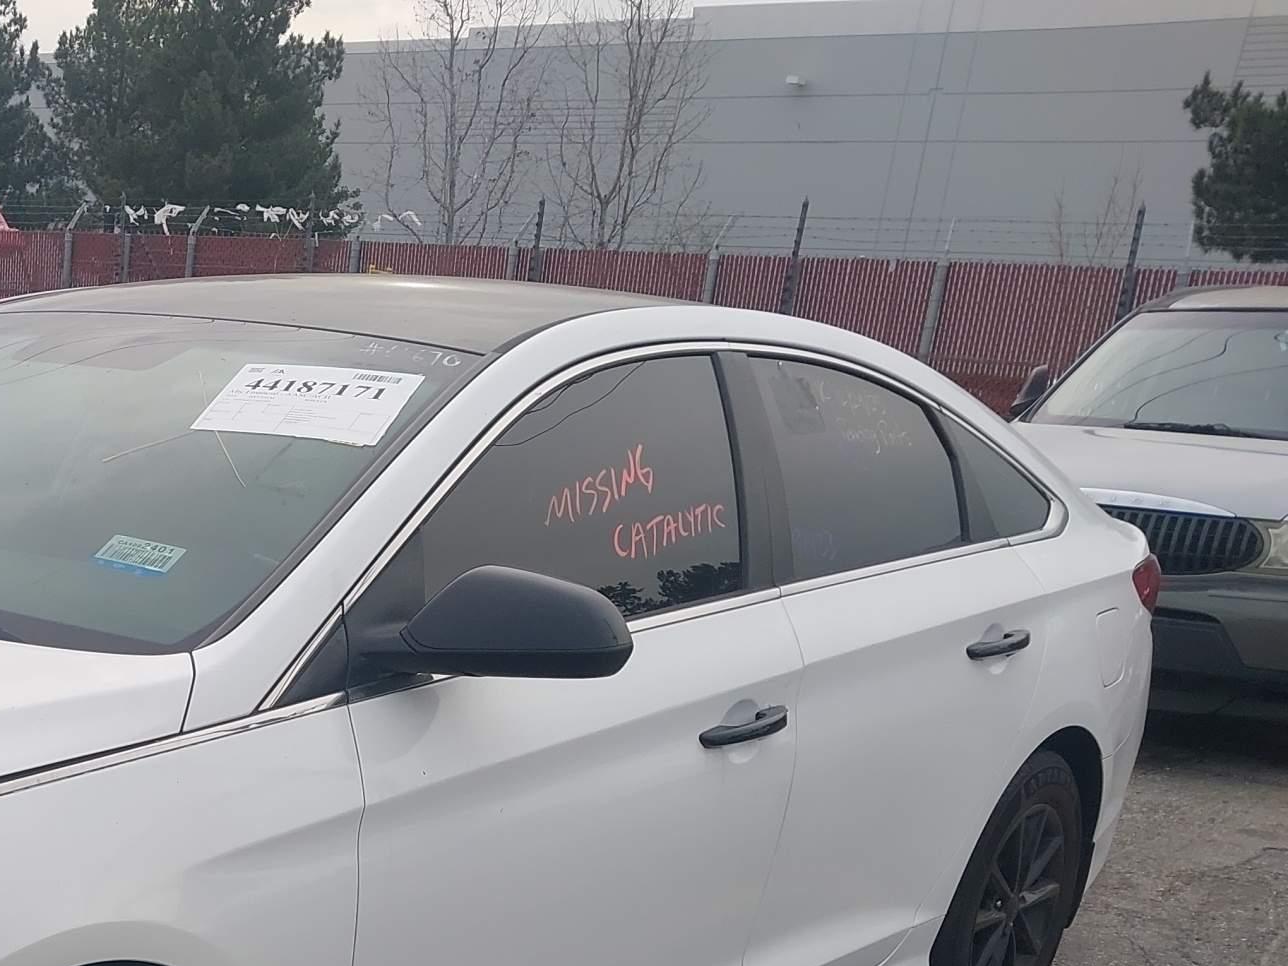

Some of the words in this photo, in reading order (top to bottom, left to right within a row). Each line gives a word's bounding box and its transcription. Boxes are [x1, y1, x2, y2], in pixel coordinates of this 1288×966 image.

[244, 377, 387, 401] 44187171
[544, 443, 654, 528] MISSING
[614, 503, 727, 560] CATALYTIC
